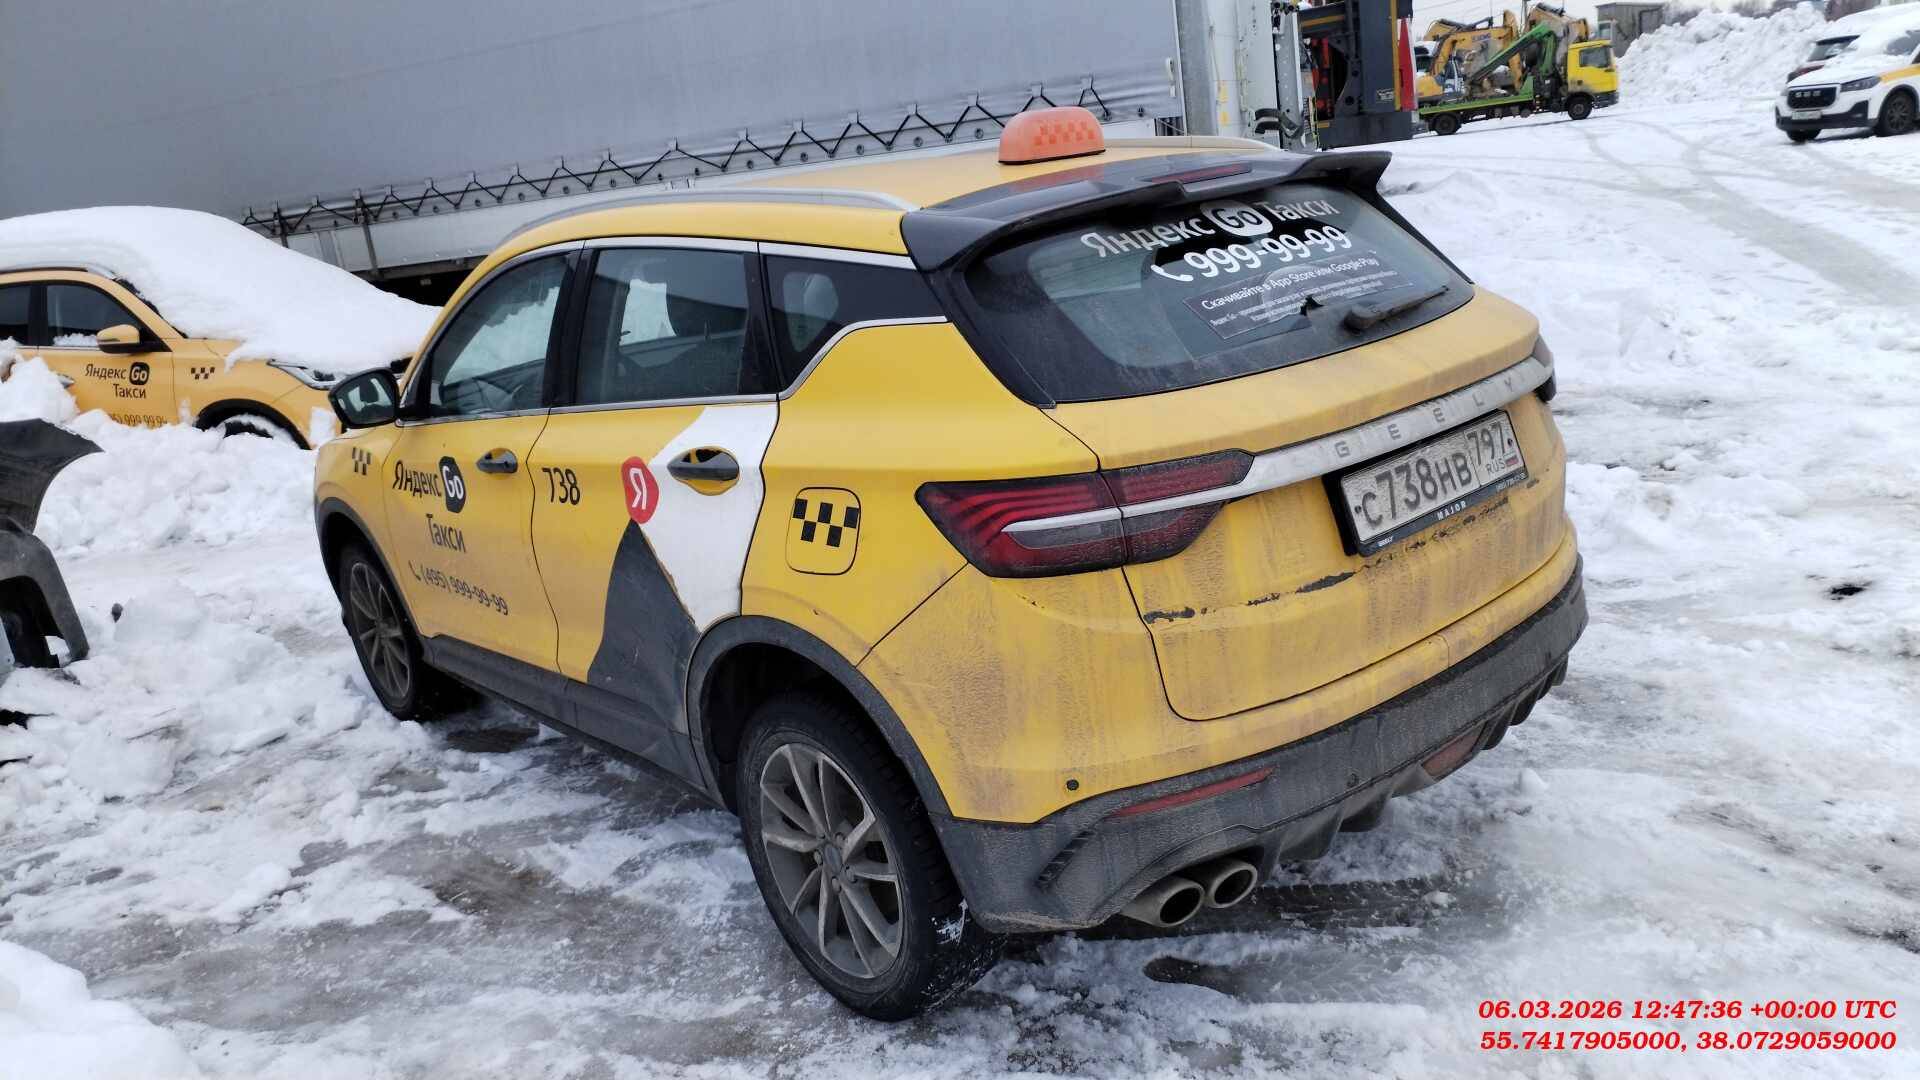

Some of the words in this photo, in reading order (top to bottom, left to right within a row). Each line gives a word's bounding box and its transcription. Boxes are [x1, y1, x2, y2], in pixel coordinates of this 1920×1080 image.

[1081, 217, 1216, 258] Яндекс
[1261, 199, 1341, 223] Такси
[1183, 226, 1354, 278] 999-99-99
[1201, 283, 1264, 310] Скачивайте
[1269, 275, 1291, 289] App
[1290, 270, 1317, 284] Store
[1317, 266, 1332, 278] или
[1331, 259, 1362, 274] Google
[85, 363, 126, 381] Яндекс
[131, 366, 148, 382] Go
[113, 384, 147, 399] Такси
[1333, 378, 1515, 459] GEELY
[392, 459, 443, 498] Яндекс
[442, 465, 464, 501] Go
[542, 467, 581, 506] 738
[1361, 452, 1473, 527] С738НВ
[1465, 420, 1507, 466] 797
[1486, 457, 1506, 475] RUS
[1436, 500, 1467, 521] MAJOR
[425, 513, 467, 553] Такси
[421, 567, 450, 591] (495)
[450, 573, 510, 616] 999-99-99
